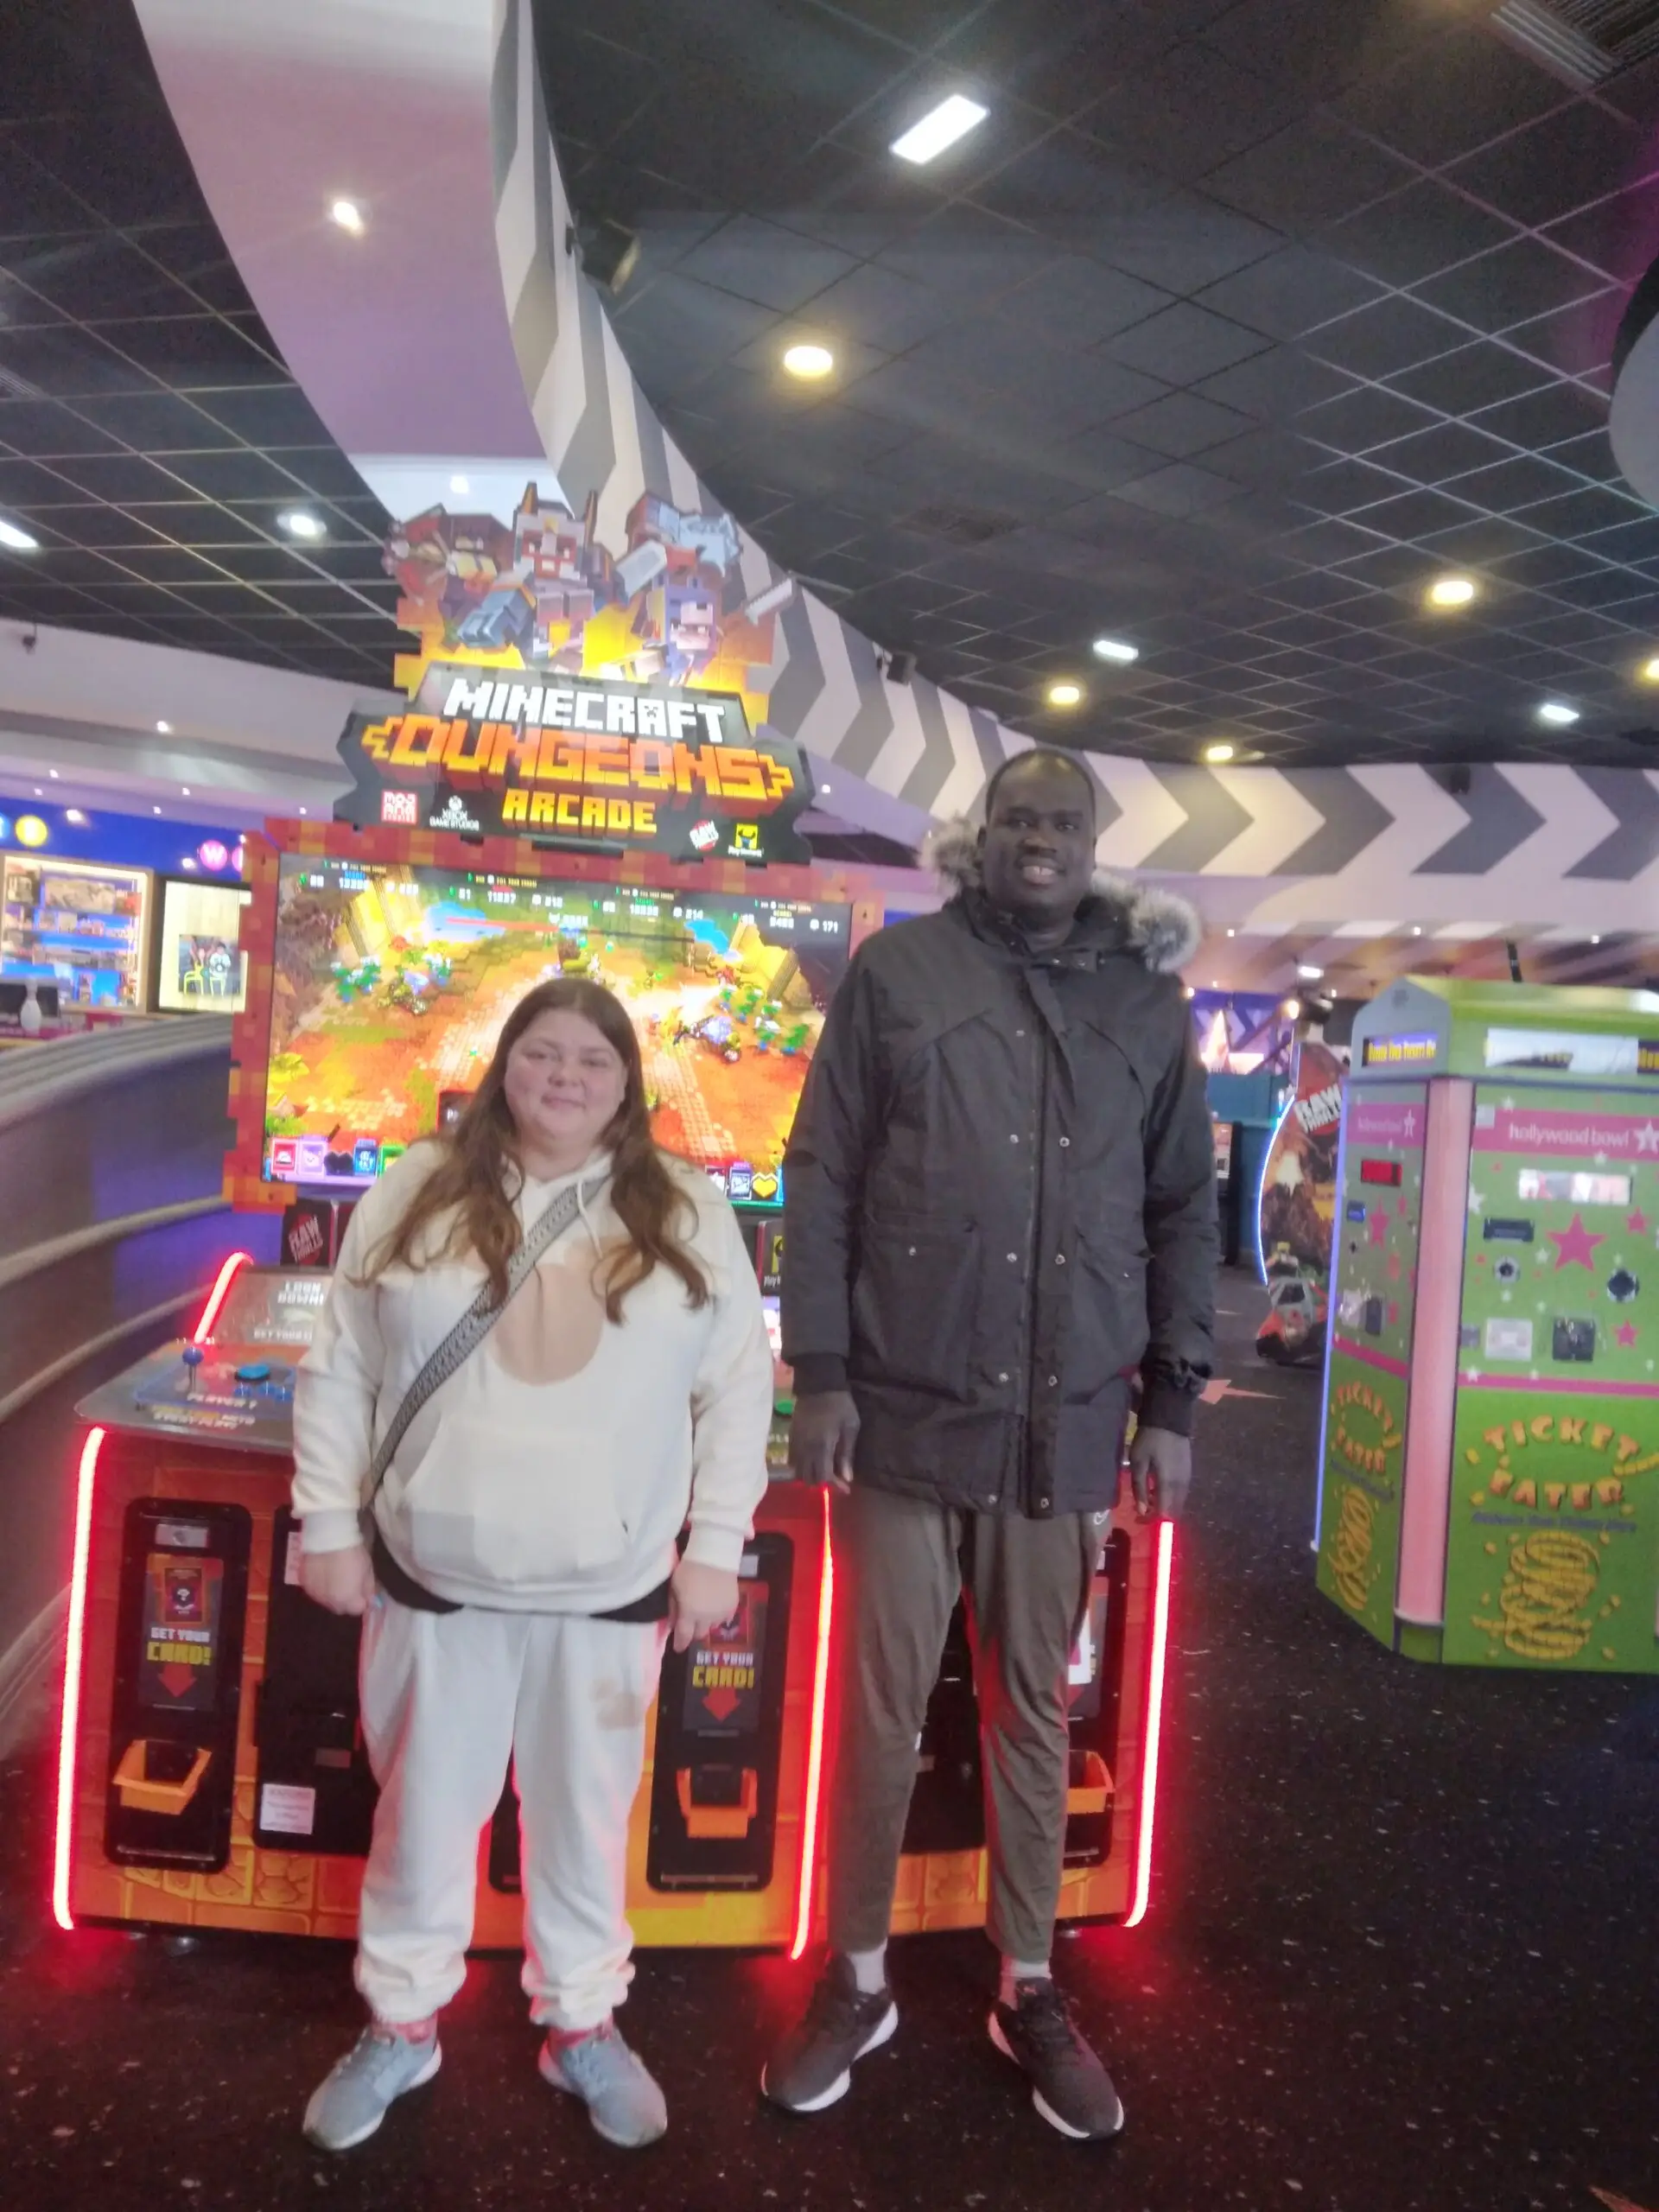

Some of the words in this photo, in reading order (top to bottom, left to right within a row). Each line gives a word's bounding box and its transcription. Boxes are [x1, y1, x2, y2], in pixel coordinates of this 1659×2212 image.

[443, 677, 725, 742] MINECRAFT
[389, 715, 772, 802] DUNGEONS
[501, 788, 658, 834] ARCADE
[1510, 1122, 1590, 1147] hollywood
[1592, 1128, 1630, 1147] bowl
[1483, 1414, 1639, 1463] TICKET
[1490, 1468, 1624, 1510] EATER
[151, 1626, 175, 1640] GET
[147, 1641, 212, 1667] CARD!
[696, 1650, 720, 1667] GET
[722, 1651, 753, 1668] YOUR
[693, 1665, 754, 1689] CARD!
